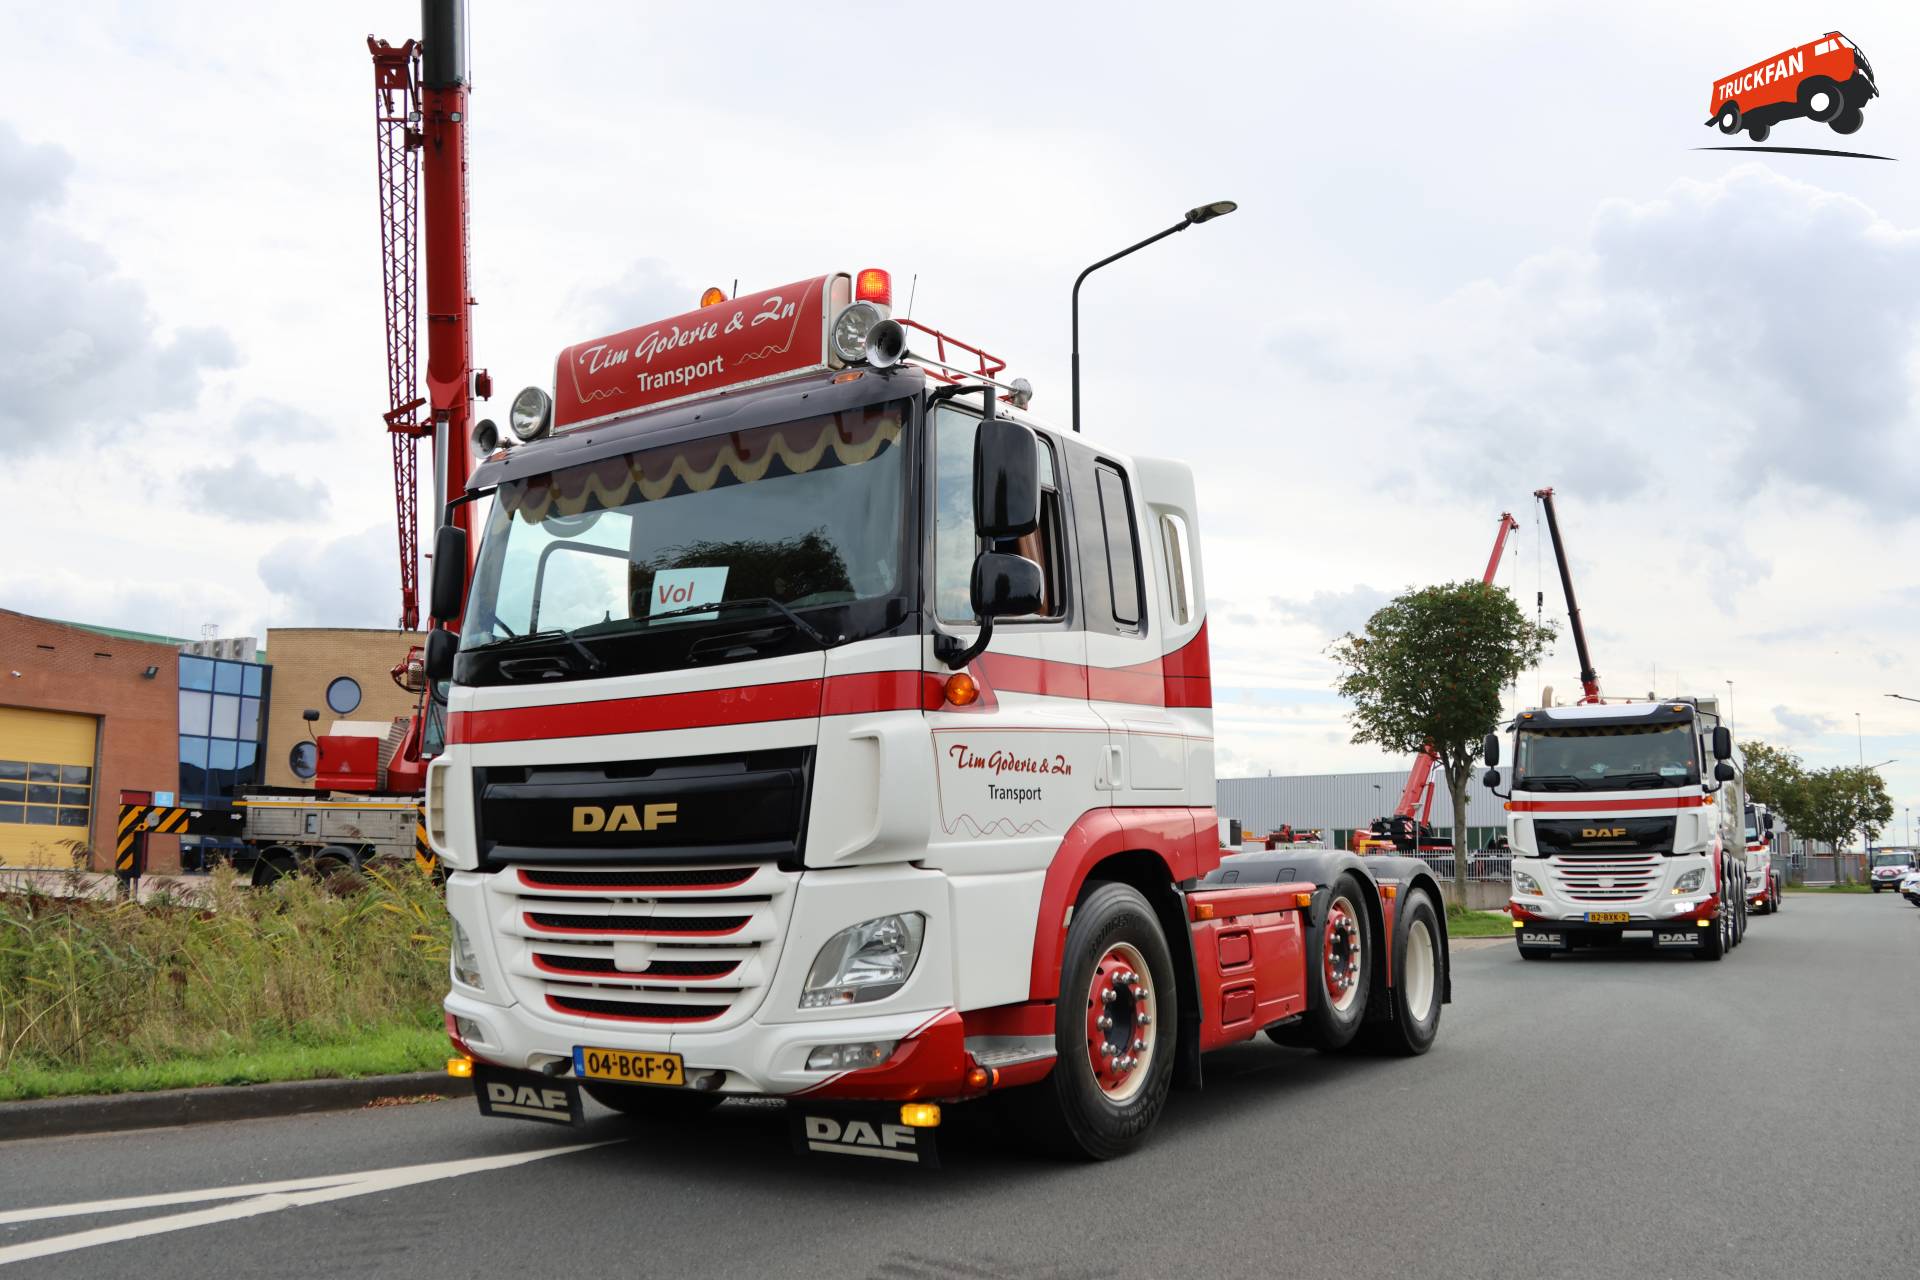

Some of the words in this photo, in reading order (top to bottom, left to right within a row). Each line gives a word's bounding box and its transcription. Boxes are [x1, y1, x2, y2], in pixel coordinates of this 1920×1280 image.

[579, 344, 629, 375] Tim
[635, 326, 718, 364] Goderie
[724, 311, 744, 334] &
[637, 355, 724, 392] Transport
[658, 582, 695, 605] Vol
[949, 744, 985, 769] Tim
[988, 750, 1037, 776] Goderie
[1039, 758, 1050, 774] &
[988, 784, 1042, 804] Transport
[572, 803, 678, 832] DAF
[1582, 828, 1627, 838] DAF
[1522, 933, 1561, 942] DAF
[1658, 933, 1699, 942] DAF
[588, 1052, 677, 1080] 04-BGF-9
[486, 1083, 569, 1109] DAF
[805, 1116, 916, 1148] DAF
